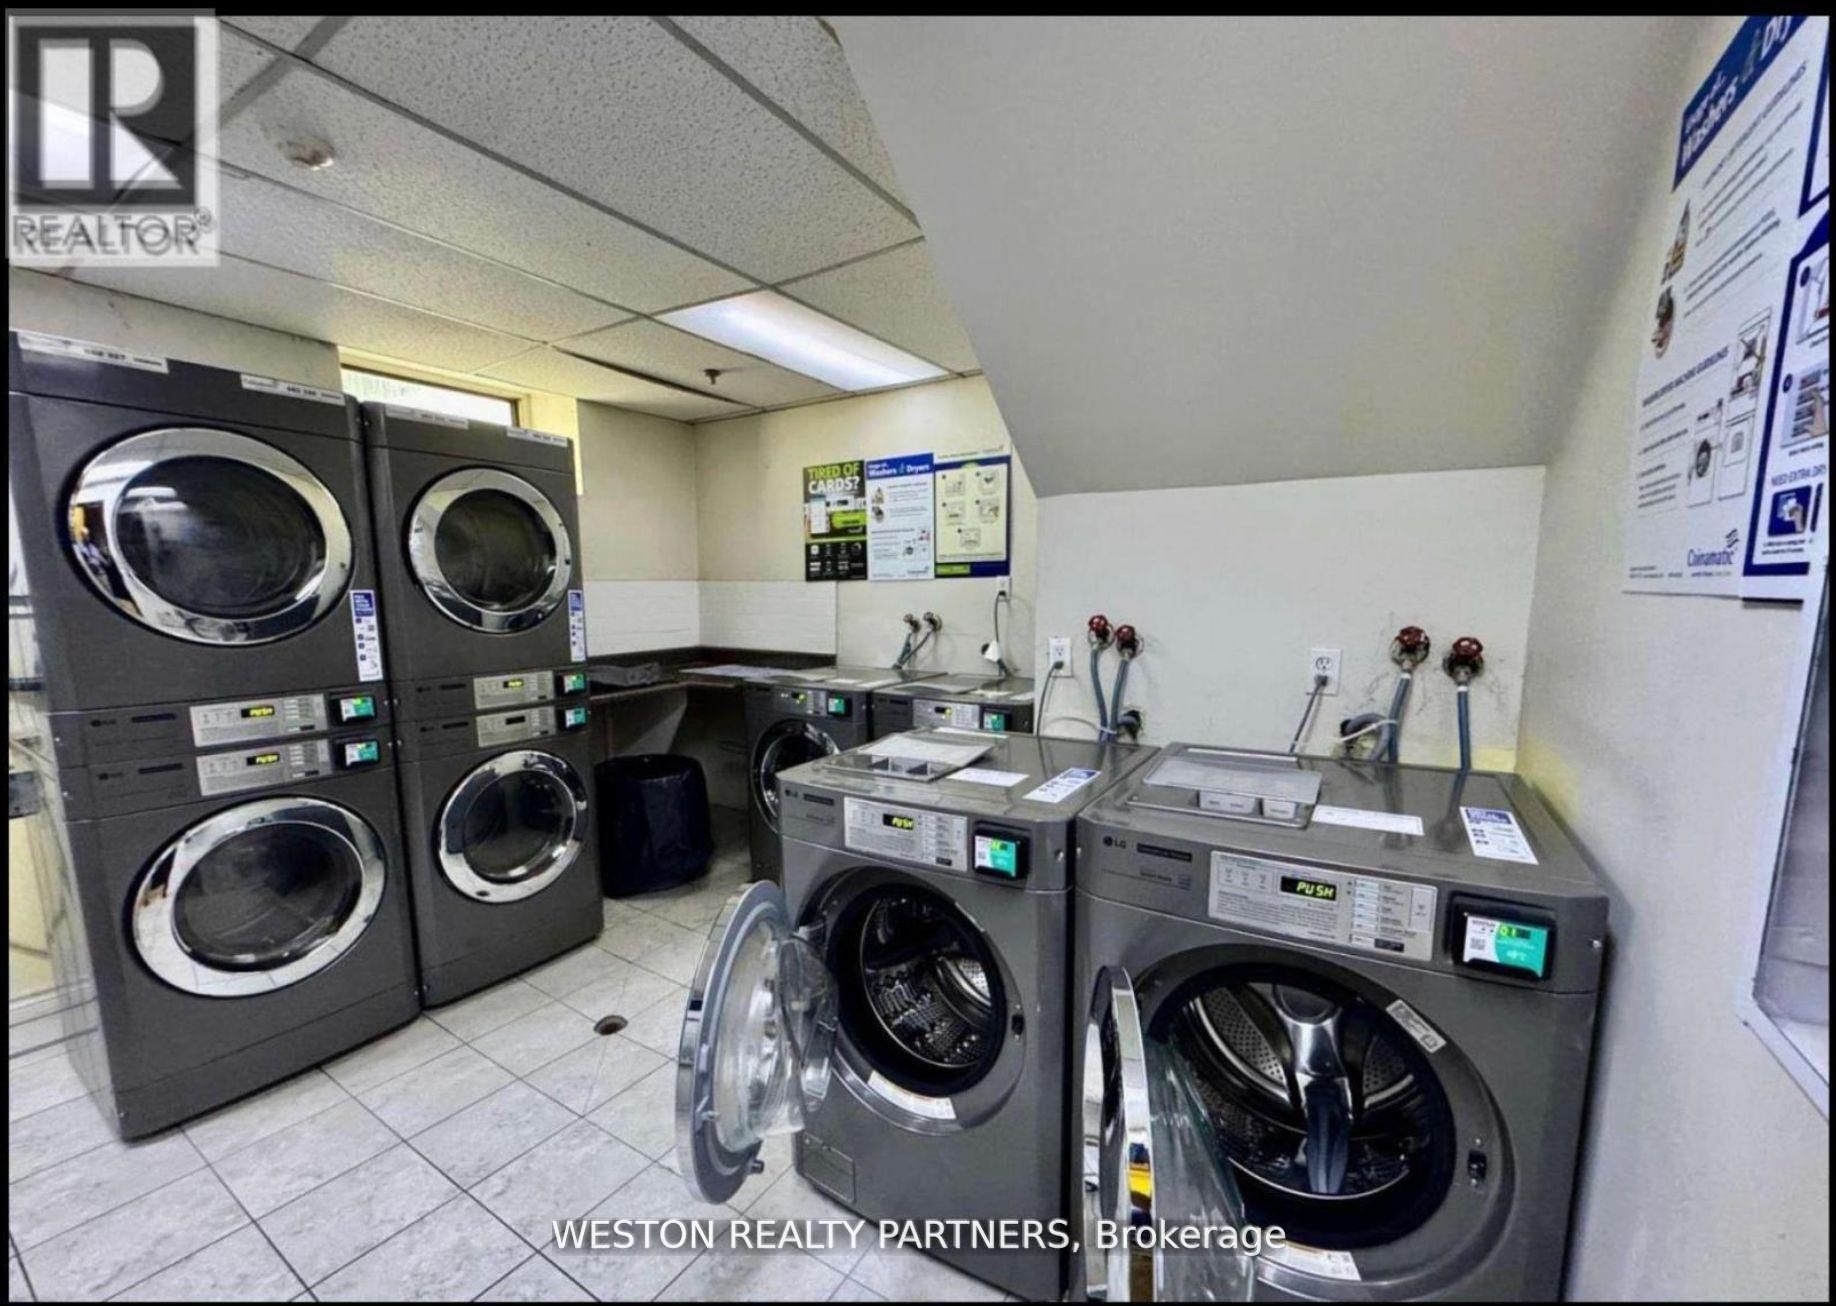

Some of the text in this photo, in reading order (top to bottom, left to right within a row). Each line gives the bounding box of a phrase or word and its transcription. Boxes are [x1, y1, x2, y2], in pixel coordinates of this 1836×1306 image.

[808, 465, 840, 480] TIRED
[843, 462, 860, 476] OF
[906, 464, 931, 475] Dryers
[808, 475, 860, 495] CARDS?
[1296, 881, 1335, 898] PUSH
